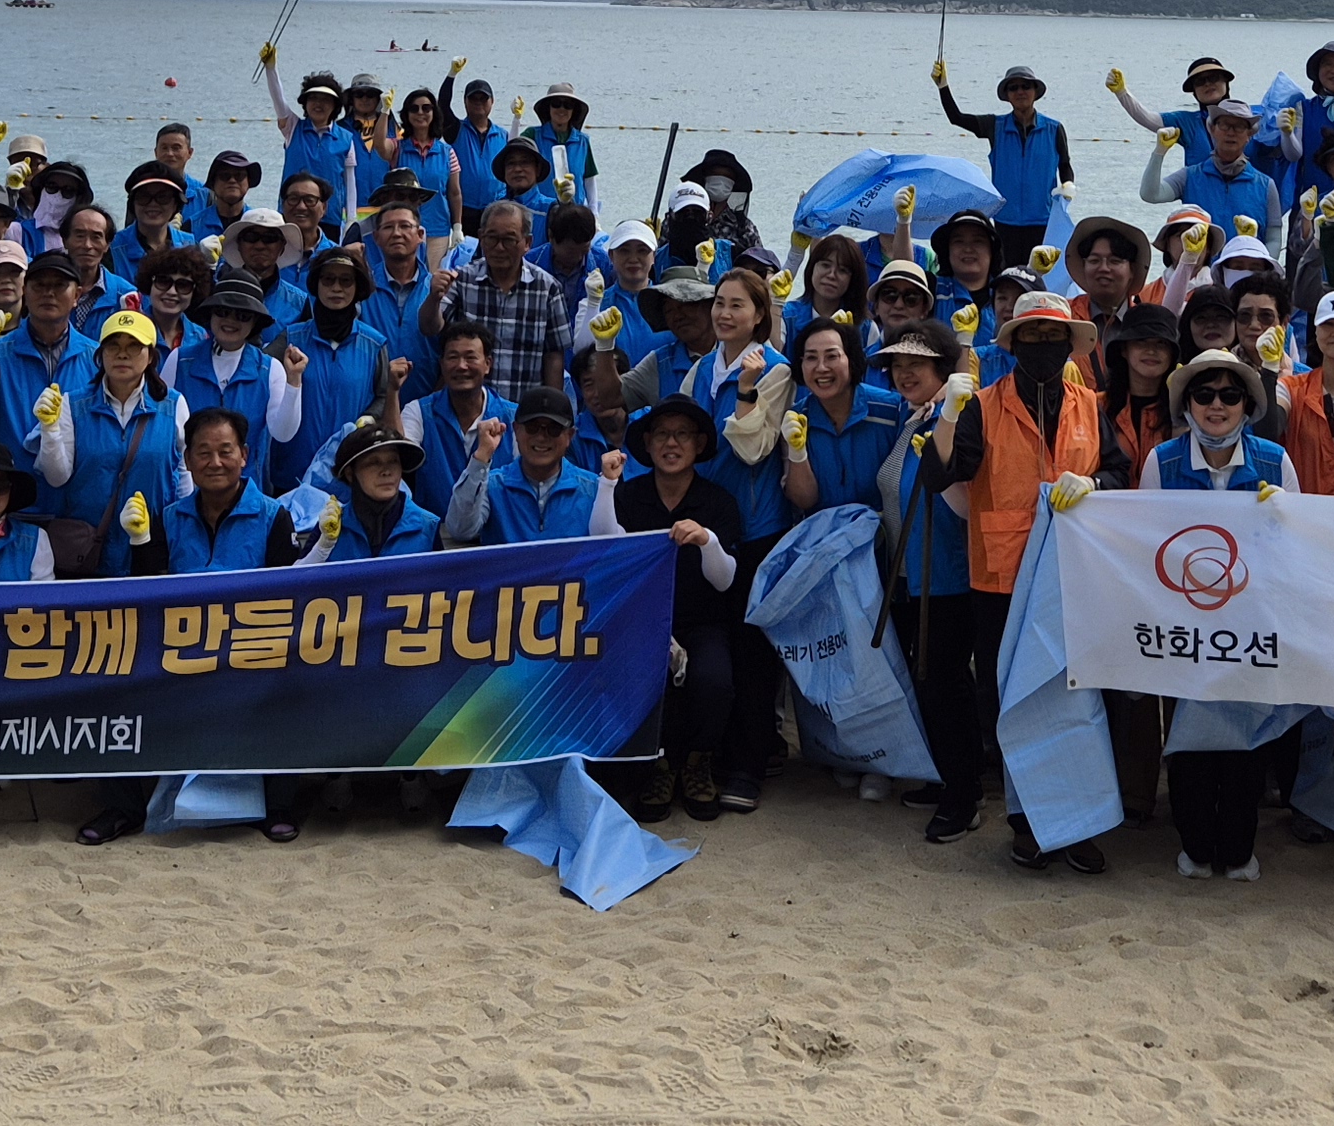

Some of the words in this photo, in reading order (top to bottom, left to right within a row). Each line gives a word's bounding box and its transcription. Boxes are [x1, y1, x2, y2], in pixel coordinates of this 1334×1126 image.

[2, 607, 140, 681] 함께
[161, 596, 364, 675] 만들어
[382, 581, 601, 668] 갑니다.
[1133, 621, 1280, 669] 한화오션
